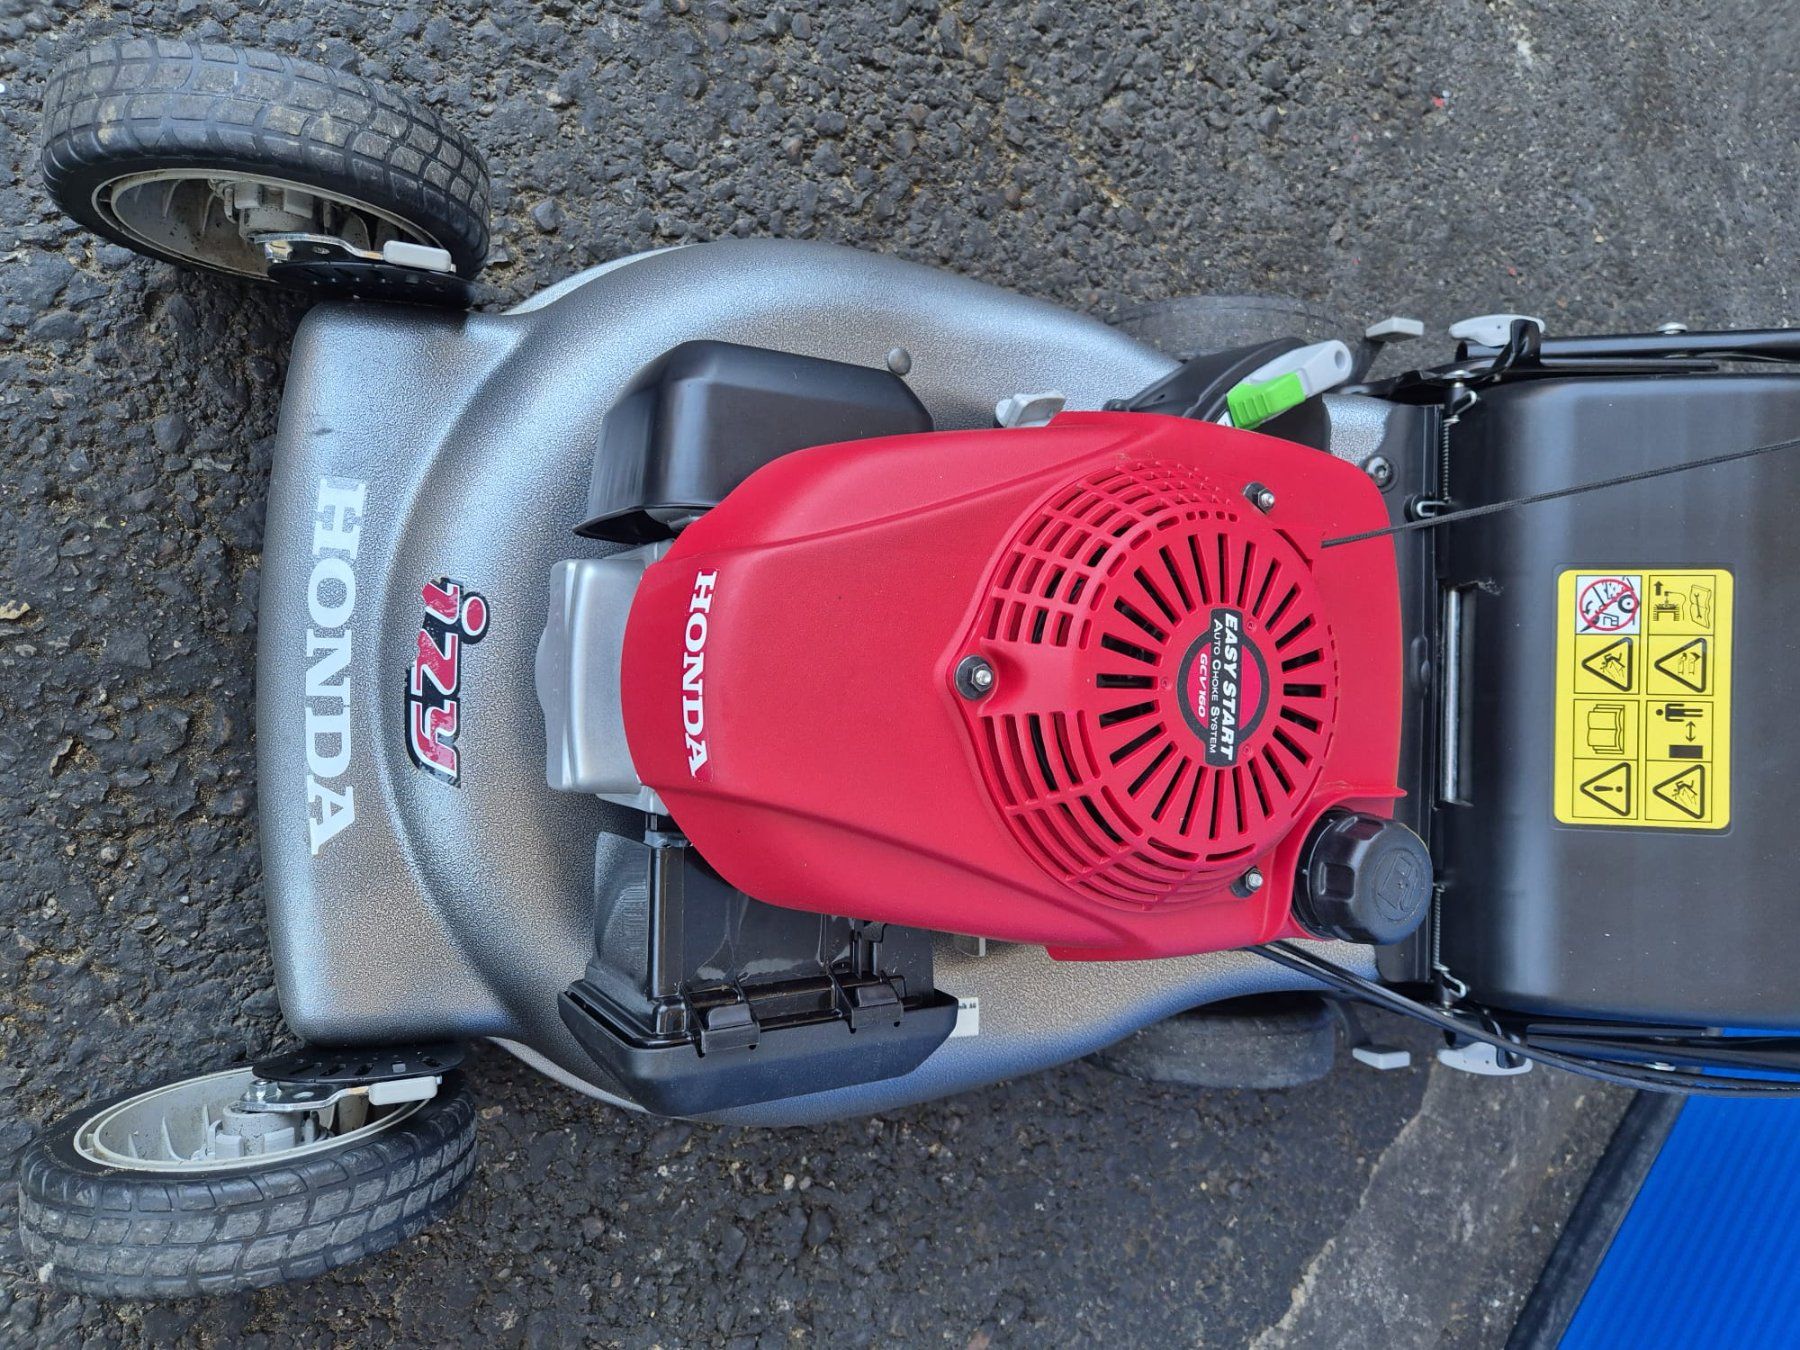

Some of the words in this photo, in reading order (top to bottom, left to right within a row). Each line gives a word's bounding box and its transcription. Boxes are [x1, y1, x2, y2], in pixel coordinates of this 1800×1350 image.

[305, 477, 367, 855] HONDA
[406, 577, 490, 788] izy
[682, 570, 718, 778] HONDA
[1220, 680, 1237, 761] START
[1223, 613, 1238, 680] EASY
